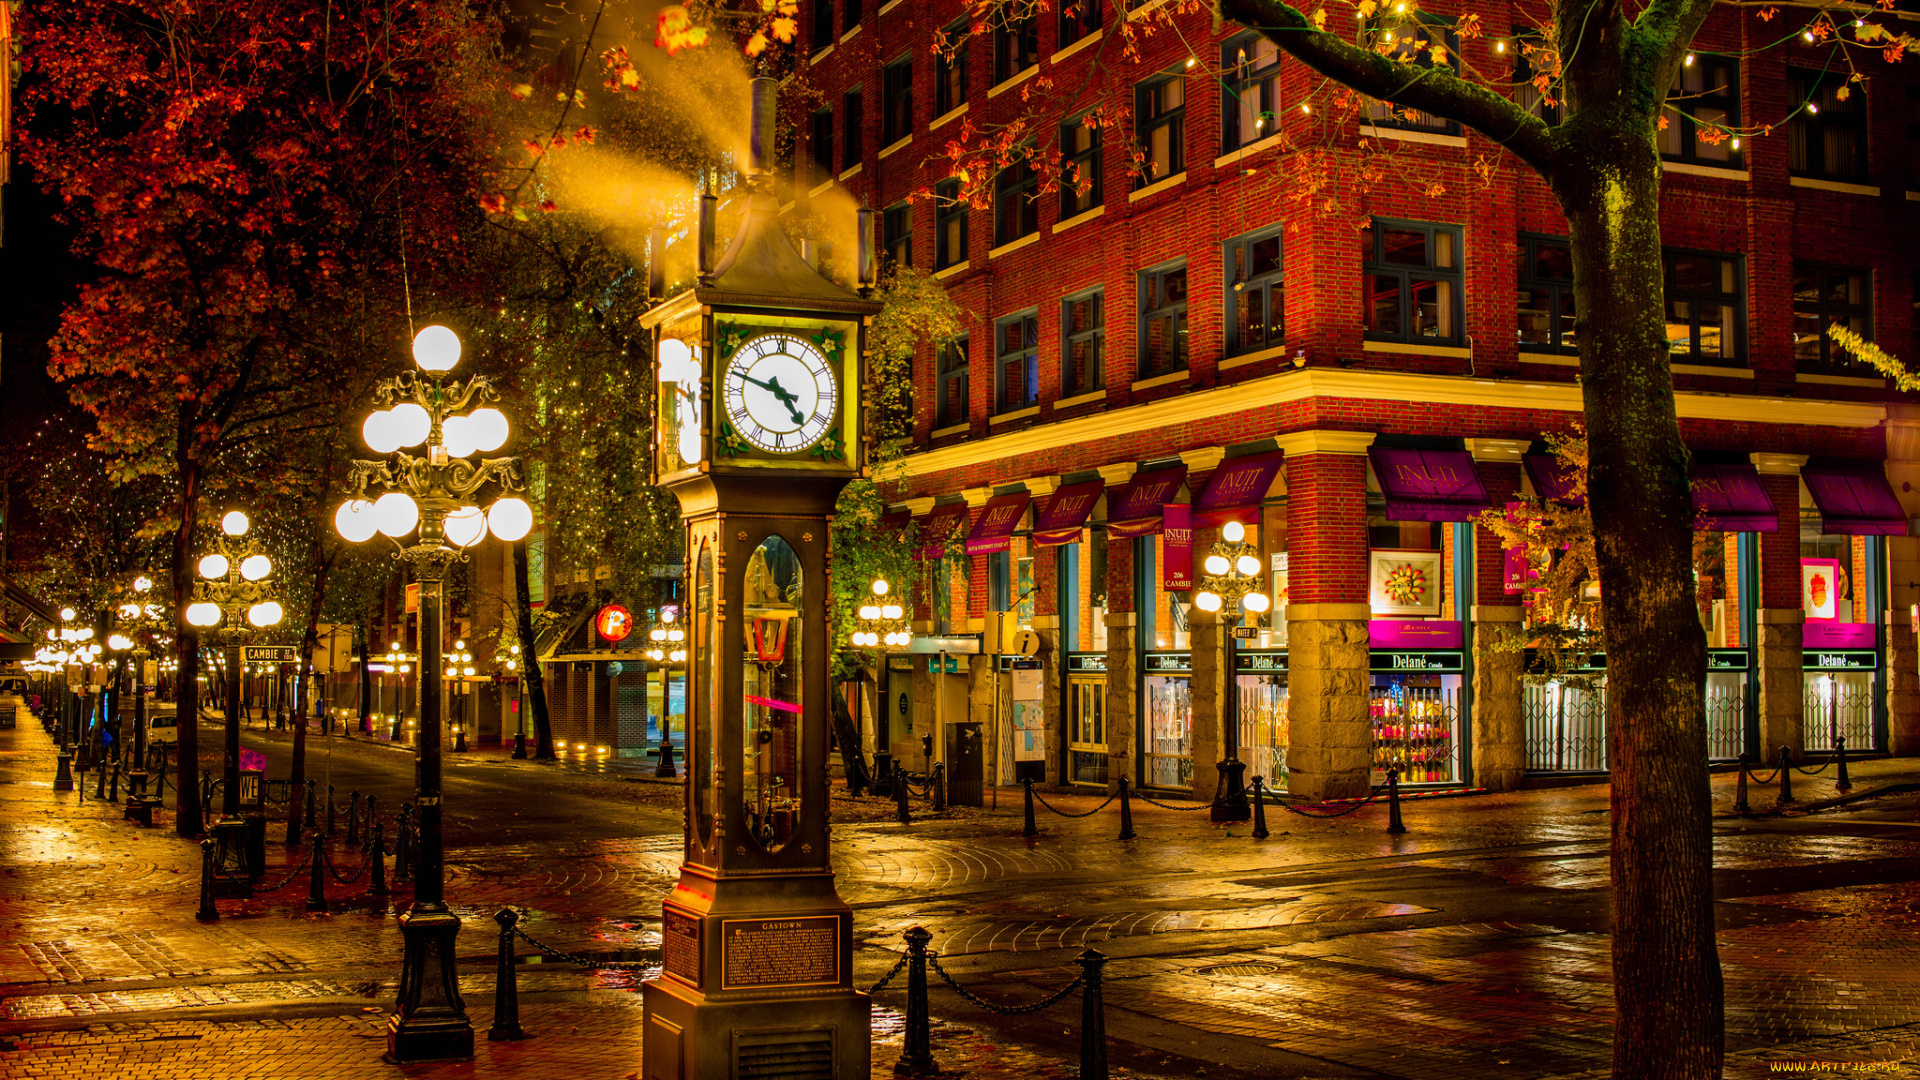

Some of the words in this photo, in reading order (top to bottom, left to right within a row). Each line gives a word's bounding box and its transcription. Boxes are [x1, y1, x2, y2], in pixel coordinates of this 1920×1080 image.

[1219, 467, 1264, 489] INUIT
[1395, 464, 1459, 481] INUIT
[1130, 482, 1170, 502] INUIT
[1054, 495, 1089, 513] INUIT
[986, 505, 1018, 522] INUIT
[1164, 528, 1192, 538] INUIT
[1237, 628, 1250, 637] WATER
[248, 649, 279, 659] CAMBIE
[1393, 654, 1426, 668] Delané
[1819, 654, 1847, 667] Delané
[1252, 655, 1273, 669] Delané
[241, 776, 258, 798] WE
[762, 922, 802, 930] GASTOWN
